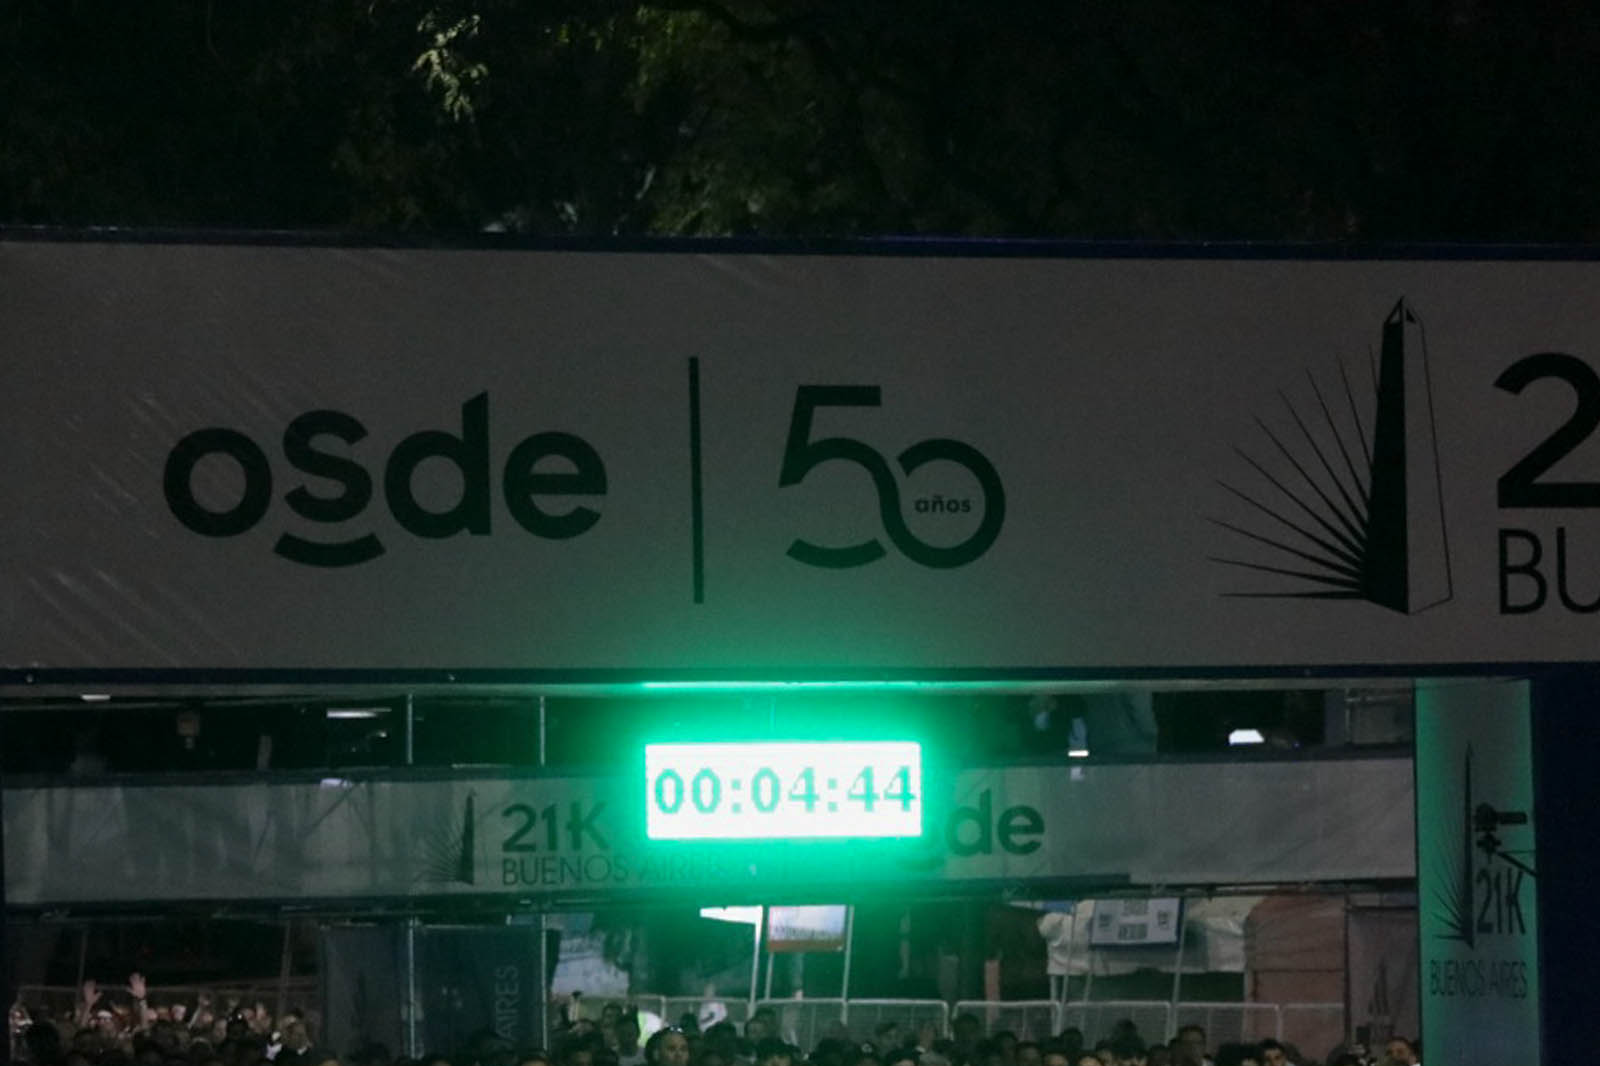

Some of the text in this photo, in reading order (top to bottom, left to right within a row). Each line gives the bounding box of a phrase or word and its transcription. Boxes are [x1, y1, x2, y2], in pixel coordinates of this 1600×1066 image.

[163, 391, 607, 565] osde
[778, 385, 1005, 568] 50
[914, 494, 971, 516] años
[654, 765, 918, 814] 00:04:44
[502, 803, 610, 853] 21K
[502, 855, 627, 885] BUENOS
[1477, 868, 1527, 935] 21K
